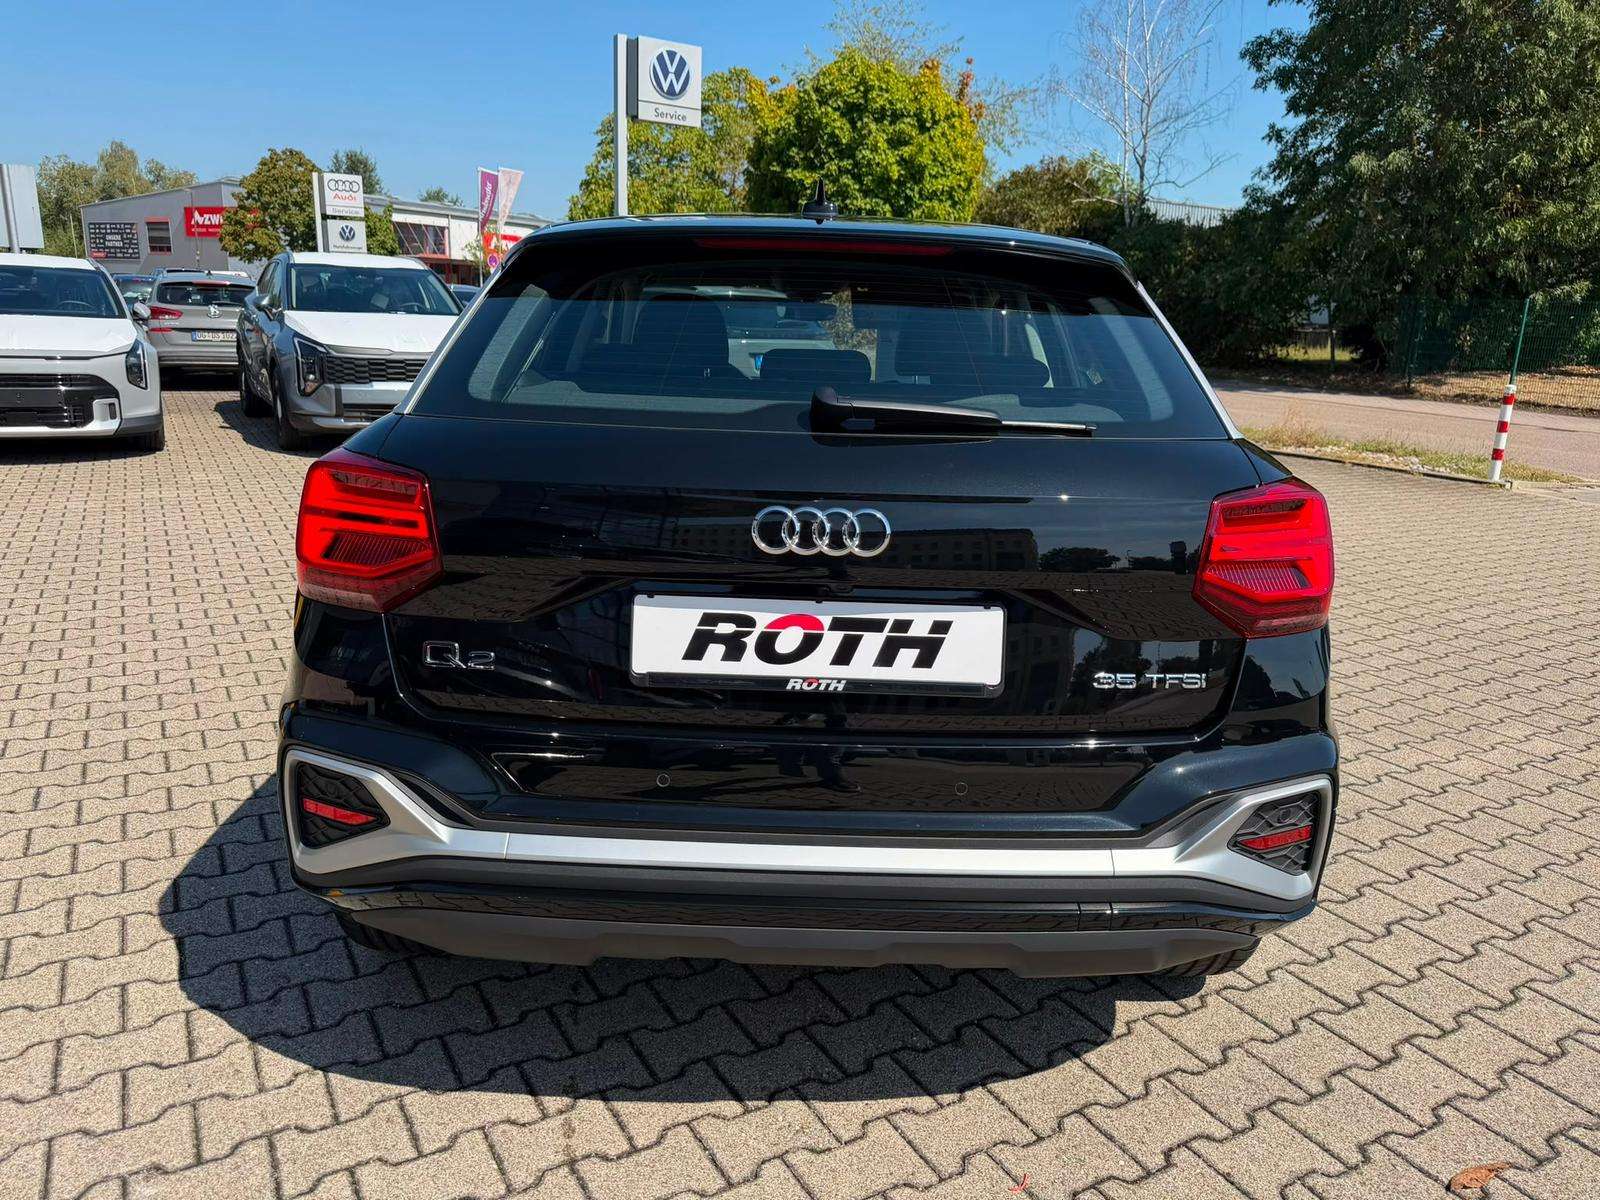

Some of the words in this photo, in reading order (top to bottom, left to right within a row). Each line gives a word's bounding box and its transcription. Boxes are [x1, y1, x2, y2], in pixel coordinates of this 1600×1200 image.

[654, 107, 687, 122] Service
[333, 193, 357, 202] Audi
[681, 611, 953, 669] ROTH
[422, 640, 496, 671] Q2
[785, 678, 847, 691] ROTH
[1092, 671, 1137, 690] 35
[1145, 672, 1208, 690] TFSI
